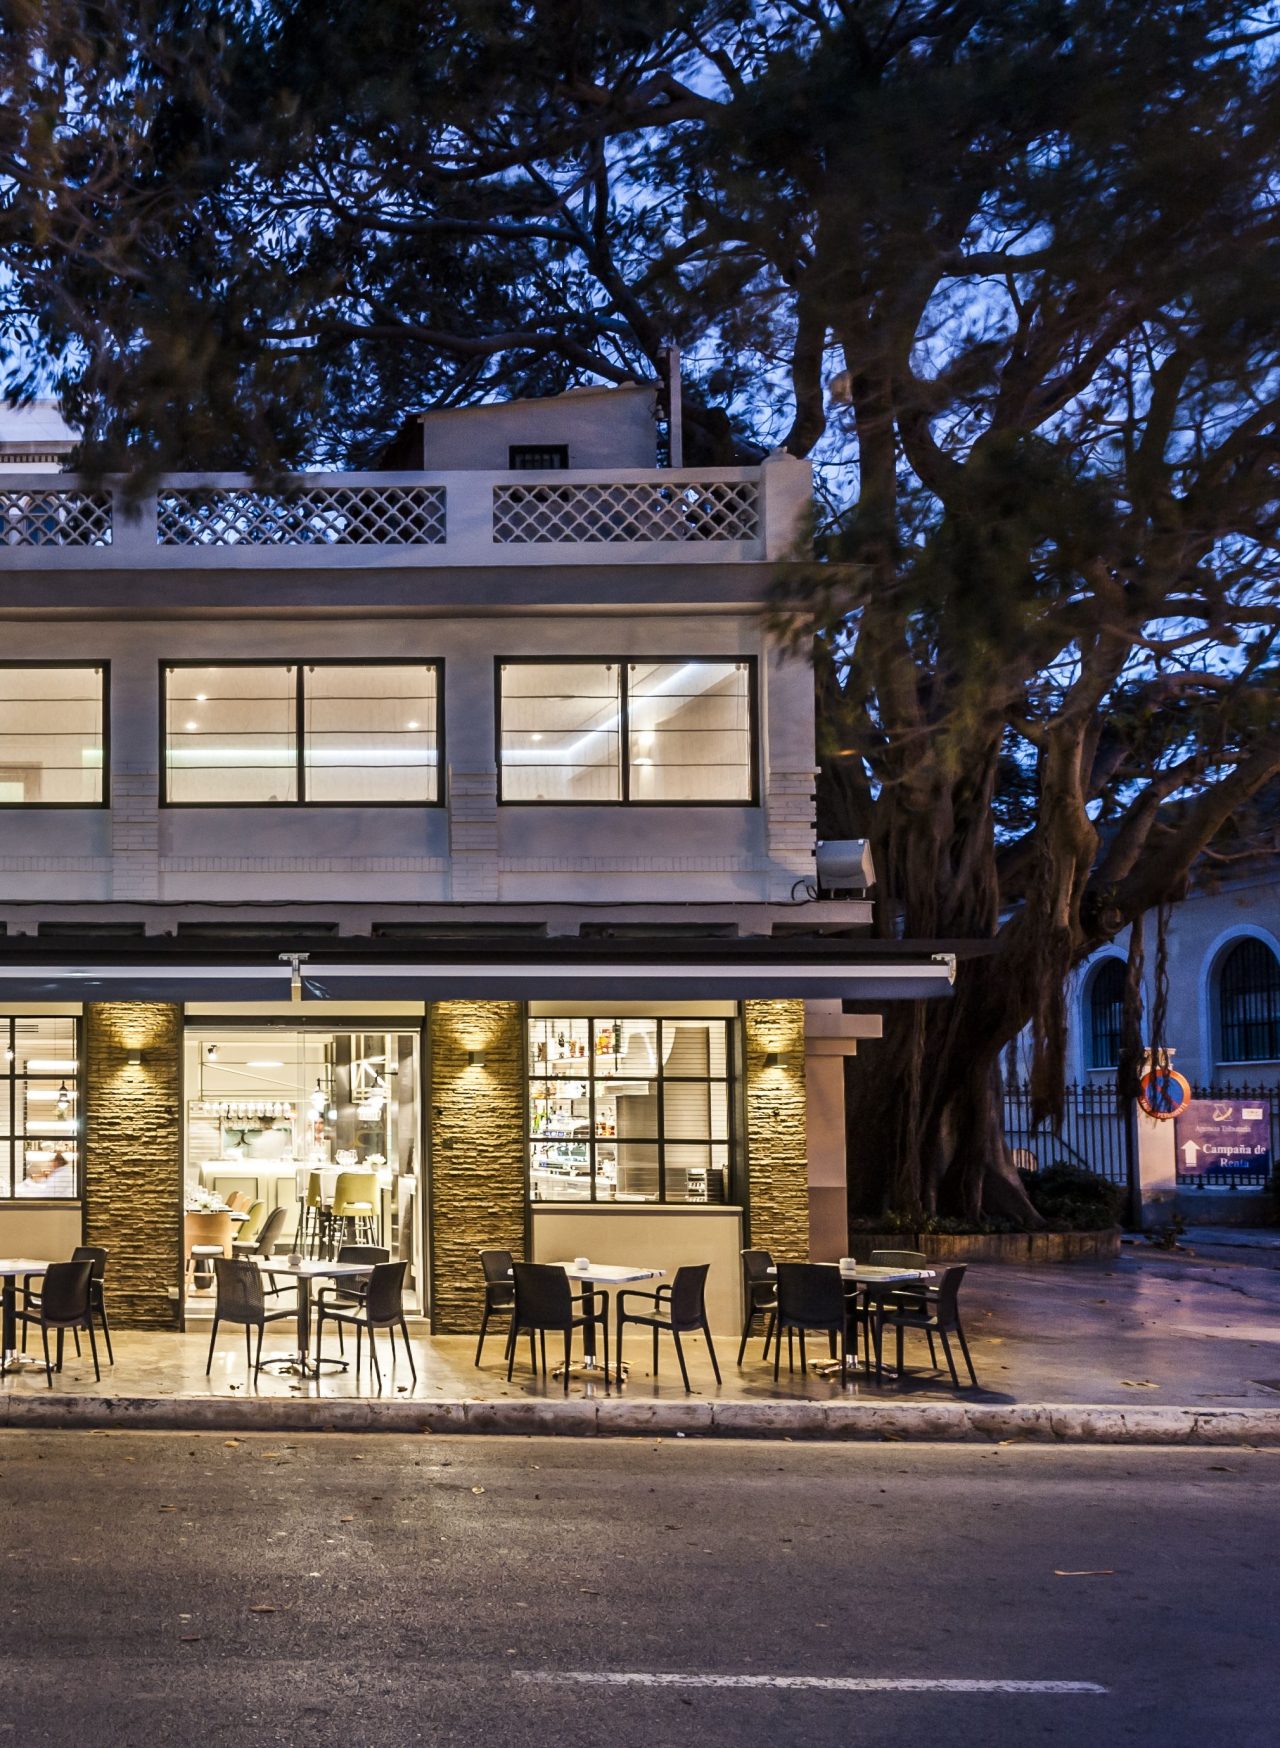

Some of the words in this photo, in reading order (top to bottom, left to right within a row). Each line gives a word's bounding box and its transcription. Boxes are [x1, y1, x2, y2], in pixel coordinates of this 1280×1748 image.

[1202, 1143, 1251, 1156] Campaña
[1254, 1144, 1266, 1154] de
[1220, 1158, 1249, 1167] Renta
